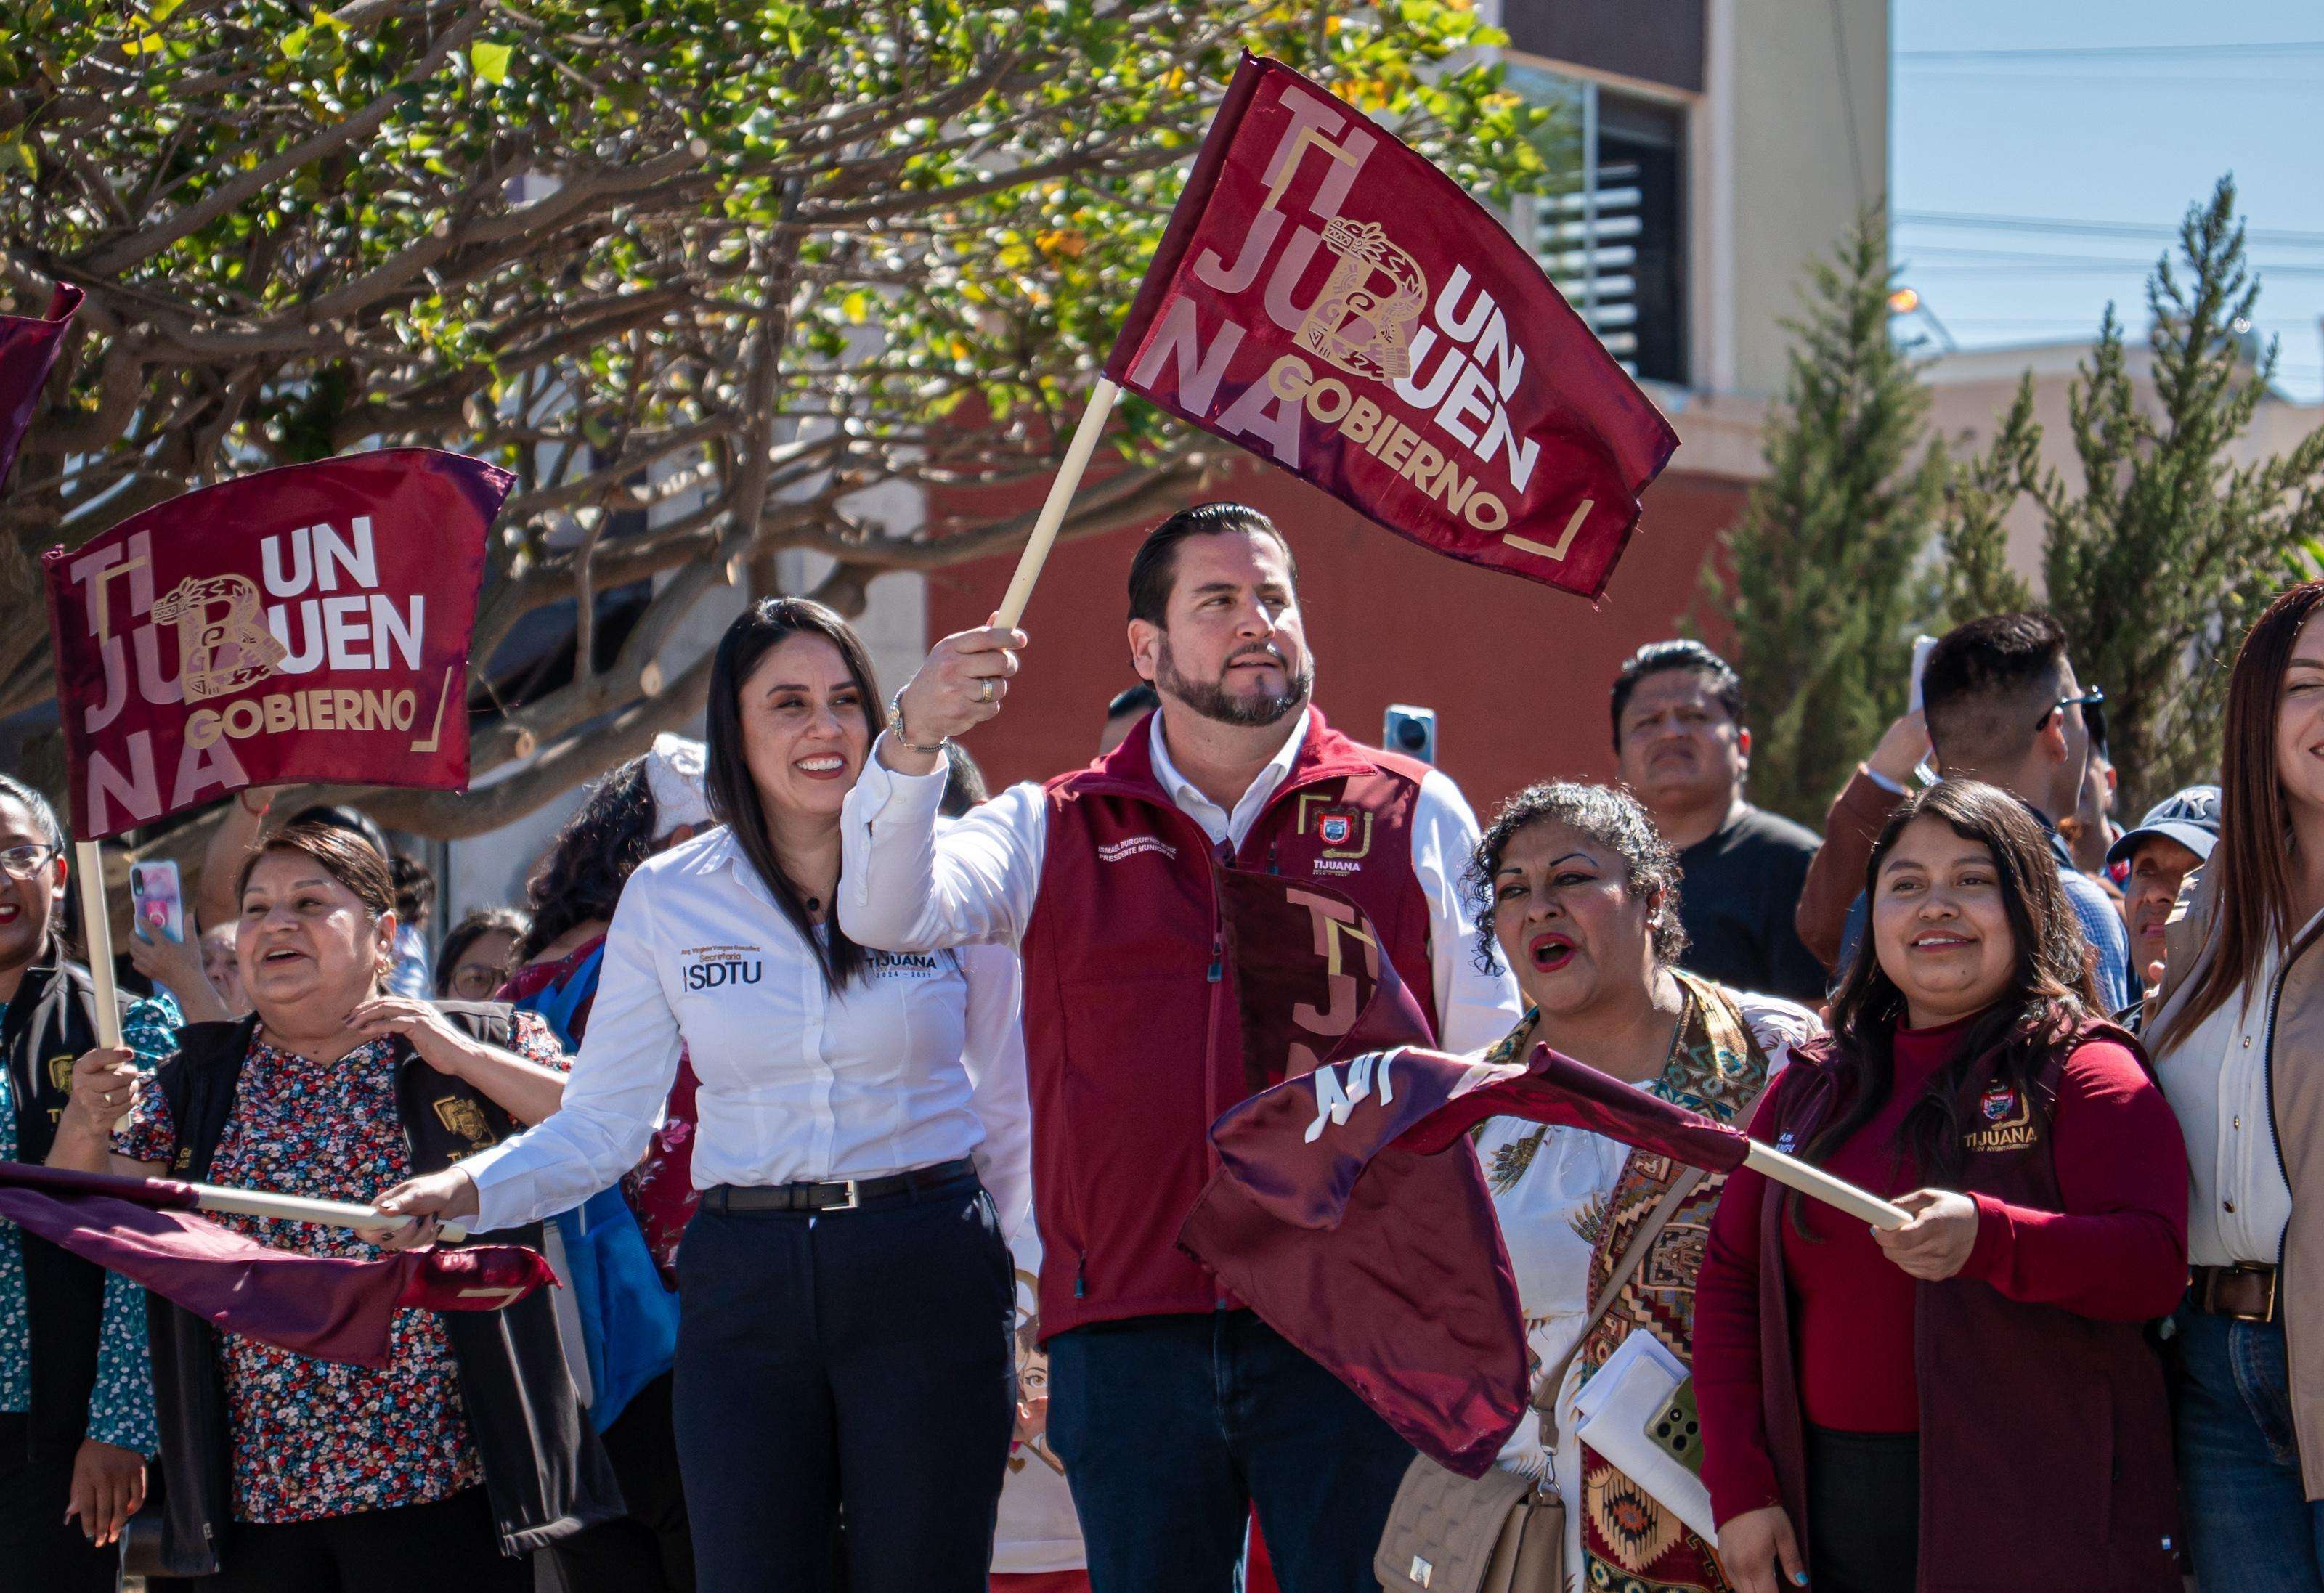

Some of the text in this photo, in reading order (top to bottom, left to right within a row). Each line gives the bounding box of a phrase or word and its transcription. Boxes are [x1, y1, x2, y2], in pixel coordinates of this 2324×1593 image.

[1435, 264, 1525, 402] UN
[1130, 295, 1301, 469] NA
[1268, 354, 1508, 531] GOBIERNO
[261, 516, 378, 597] UN
[184, 689, 416, 749] GOBIERNO
[88, 731, 250, 838] NA
[1313, 860, 1360, 871] TIJUANA
[688, 961, 762, 990] SDTU
[1963, 1126, 2037, 1148] TIJUANA
